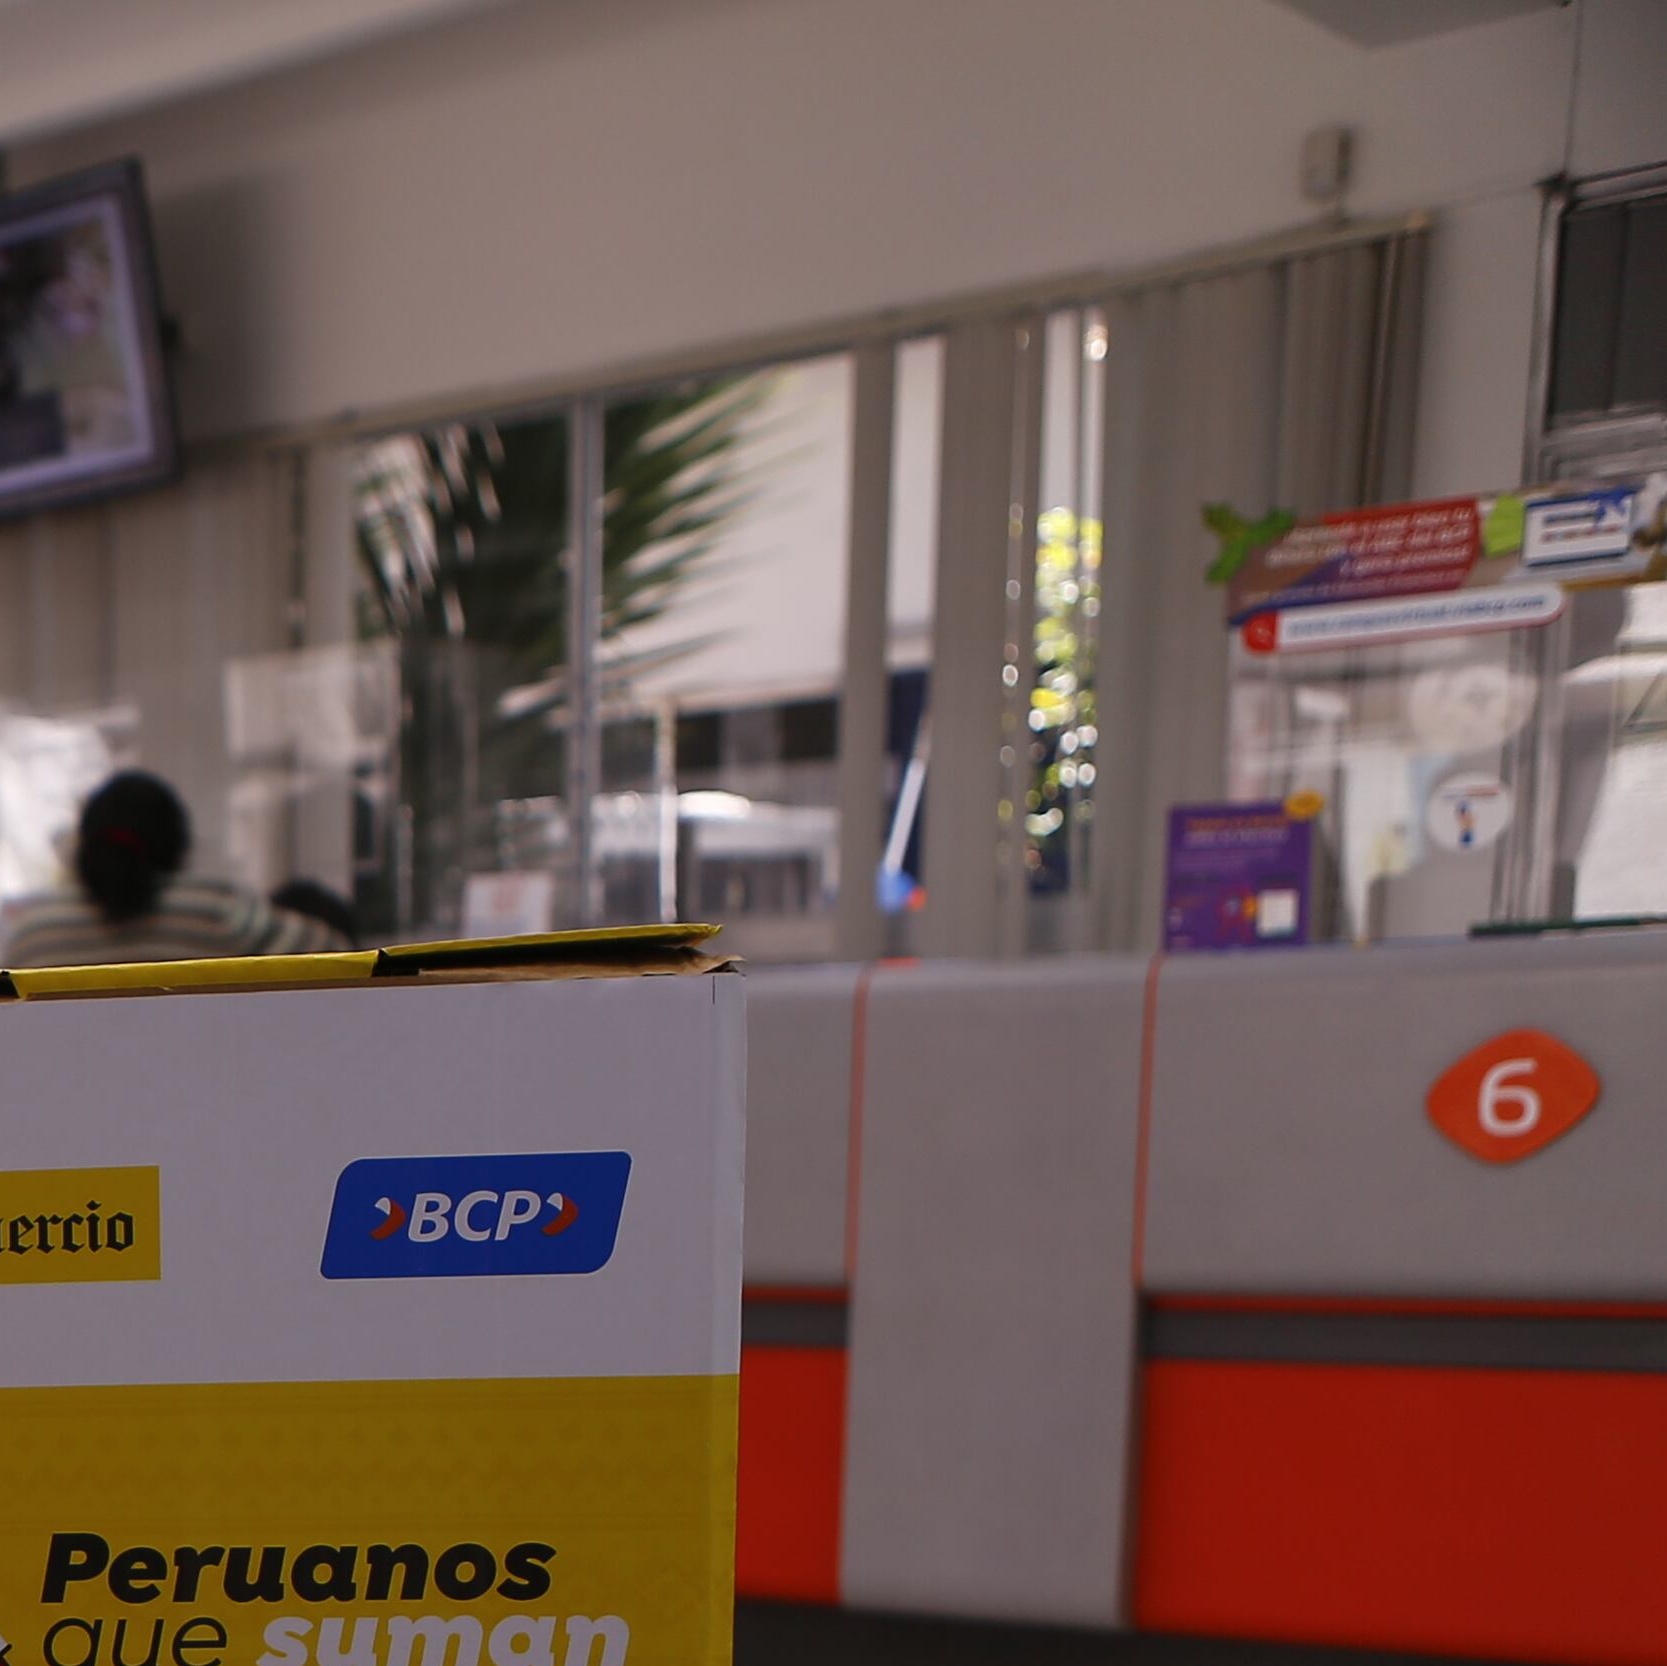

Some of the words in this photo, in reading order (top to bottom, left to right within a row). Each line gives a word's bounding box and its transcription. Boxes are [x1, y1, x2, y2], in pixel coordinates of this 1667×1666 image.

[1478, 1057, 1542, 1138] 6
[408, 1190, 542, 1242] BCP
[40, 1531, 558, 1604] Peruanos
